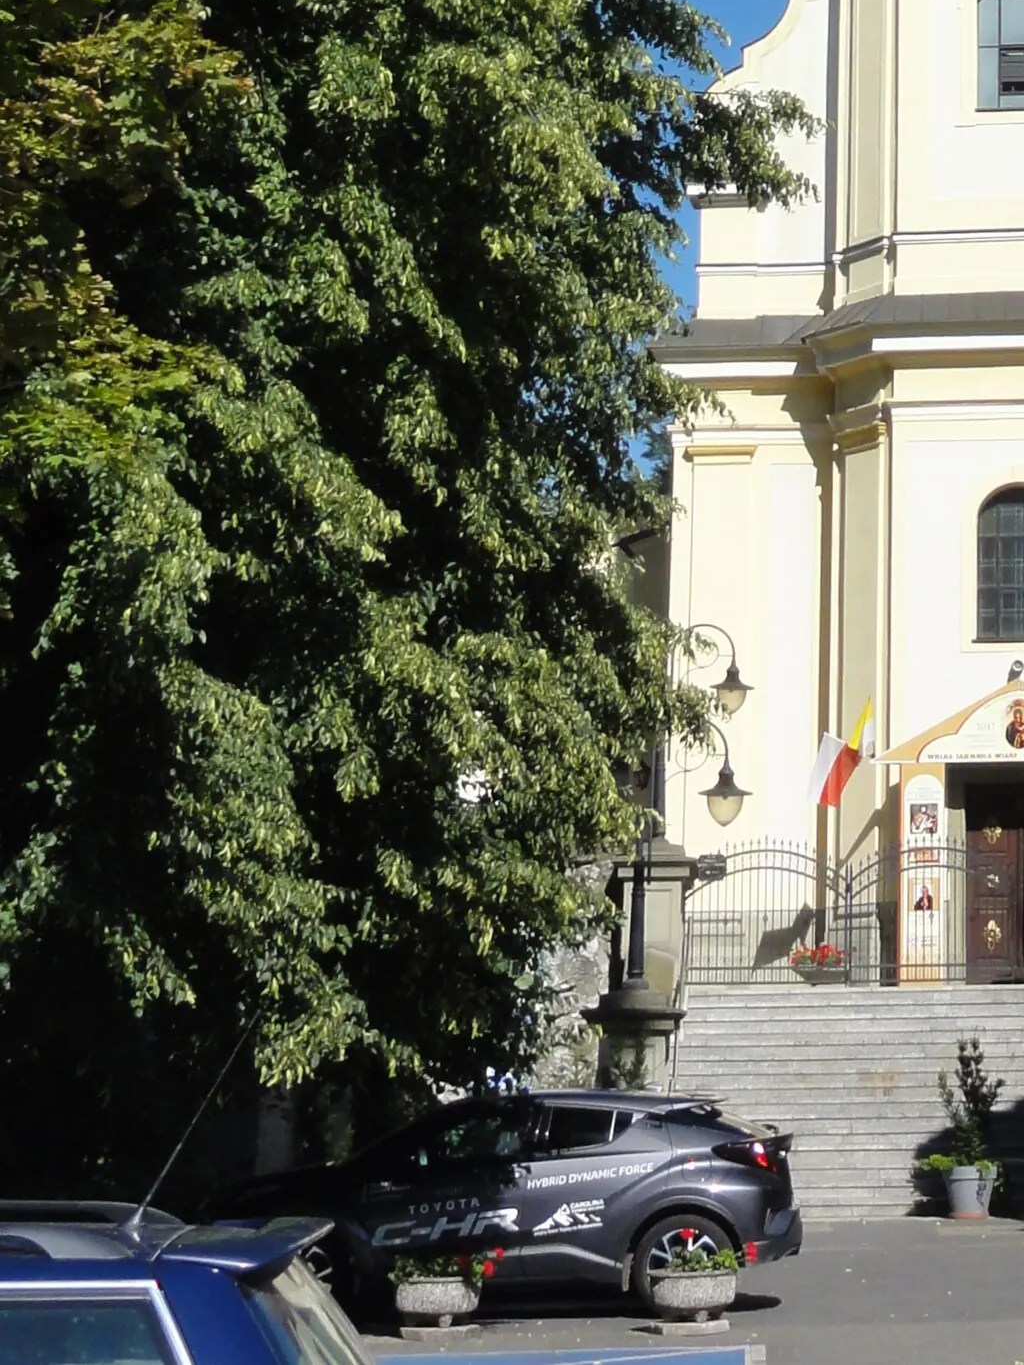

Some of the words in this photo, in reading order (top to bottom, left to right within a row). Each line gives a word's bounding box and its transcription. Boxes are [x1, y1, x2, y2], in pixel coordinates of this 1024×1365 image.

[527, 1175, 567, 1190] HYBRID
[568, 1168, 617, 1184] DYNAMIC
[619, 1163, 654, 1177] FORCE
[408, 1197, 480, 1215] TOYOTA
[371, 1208, 520, 1246] C-HR
